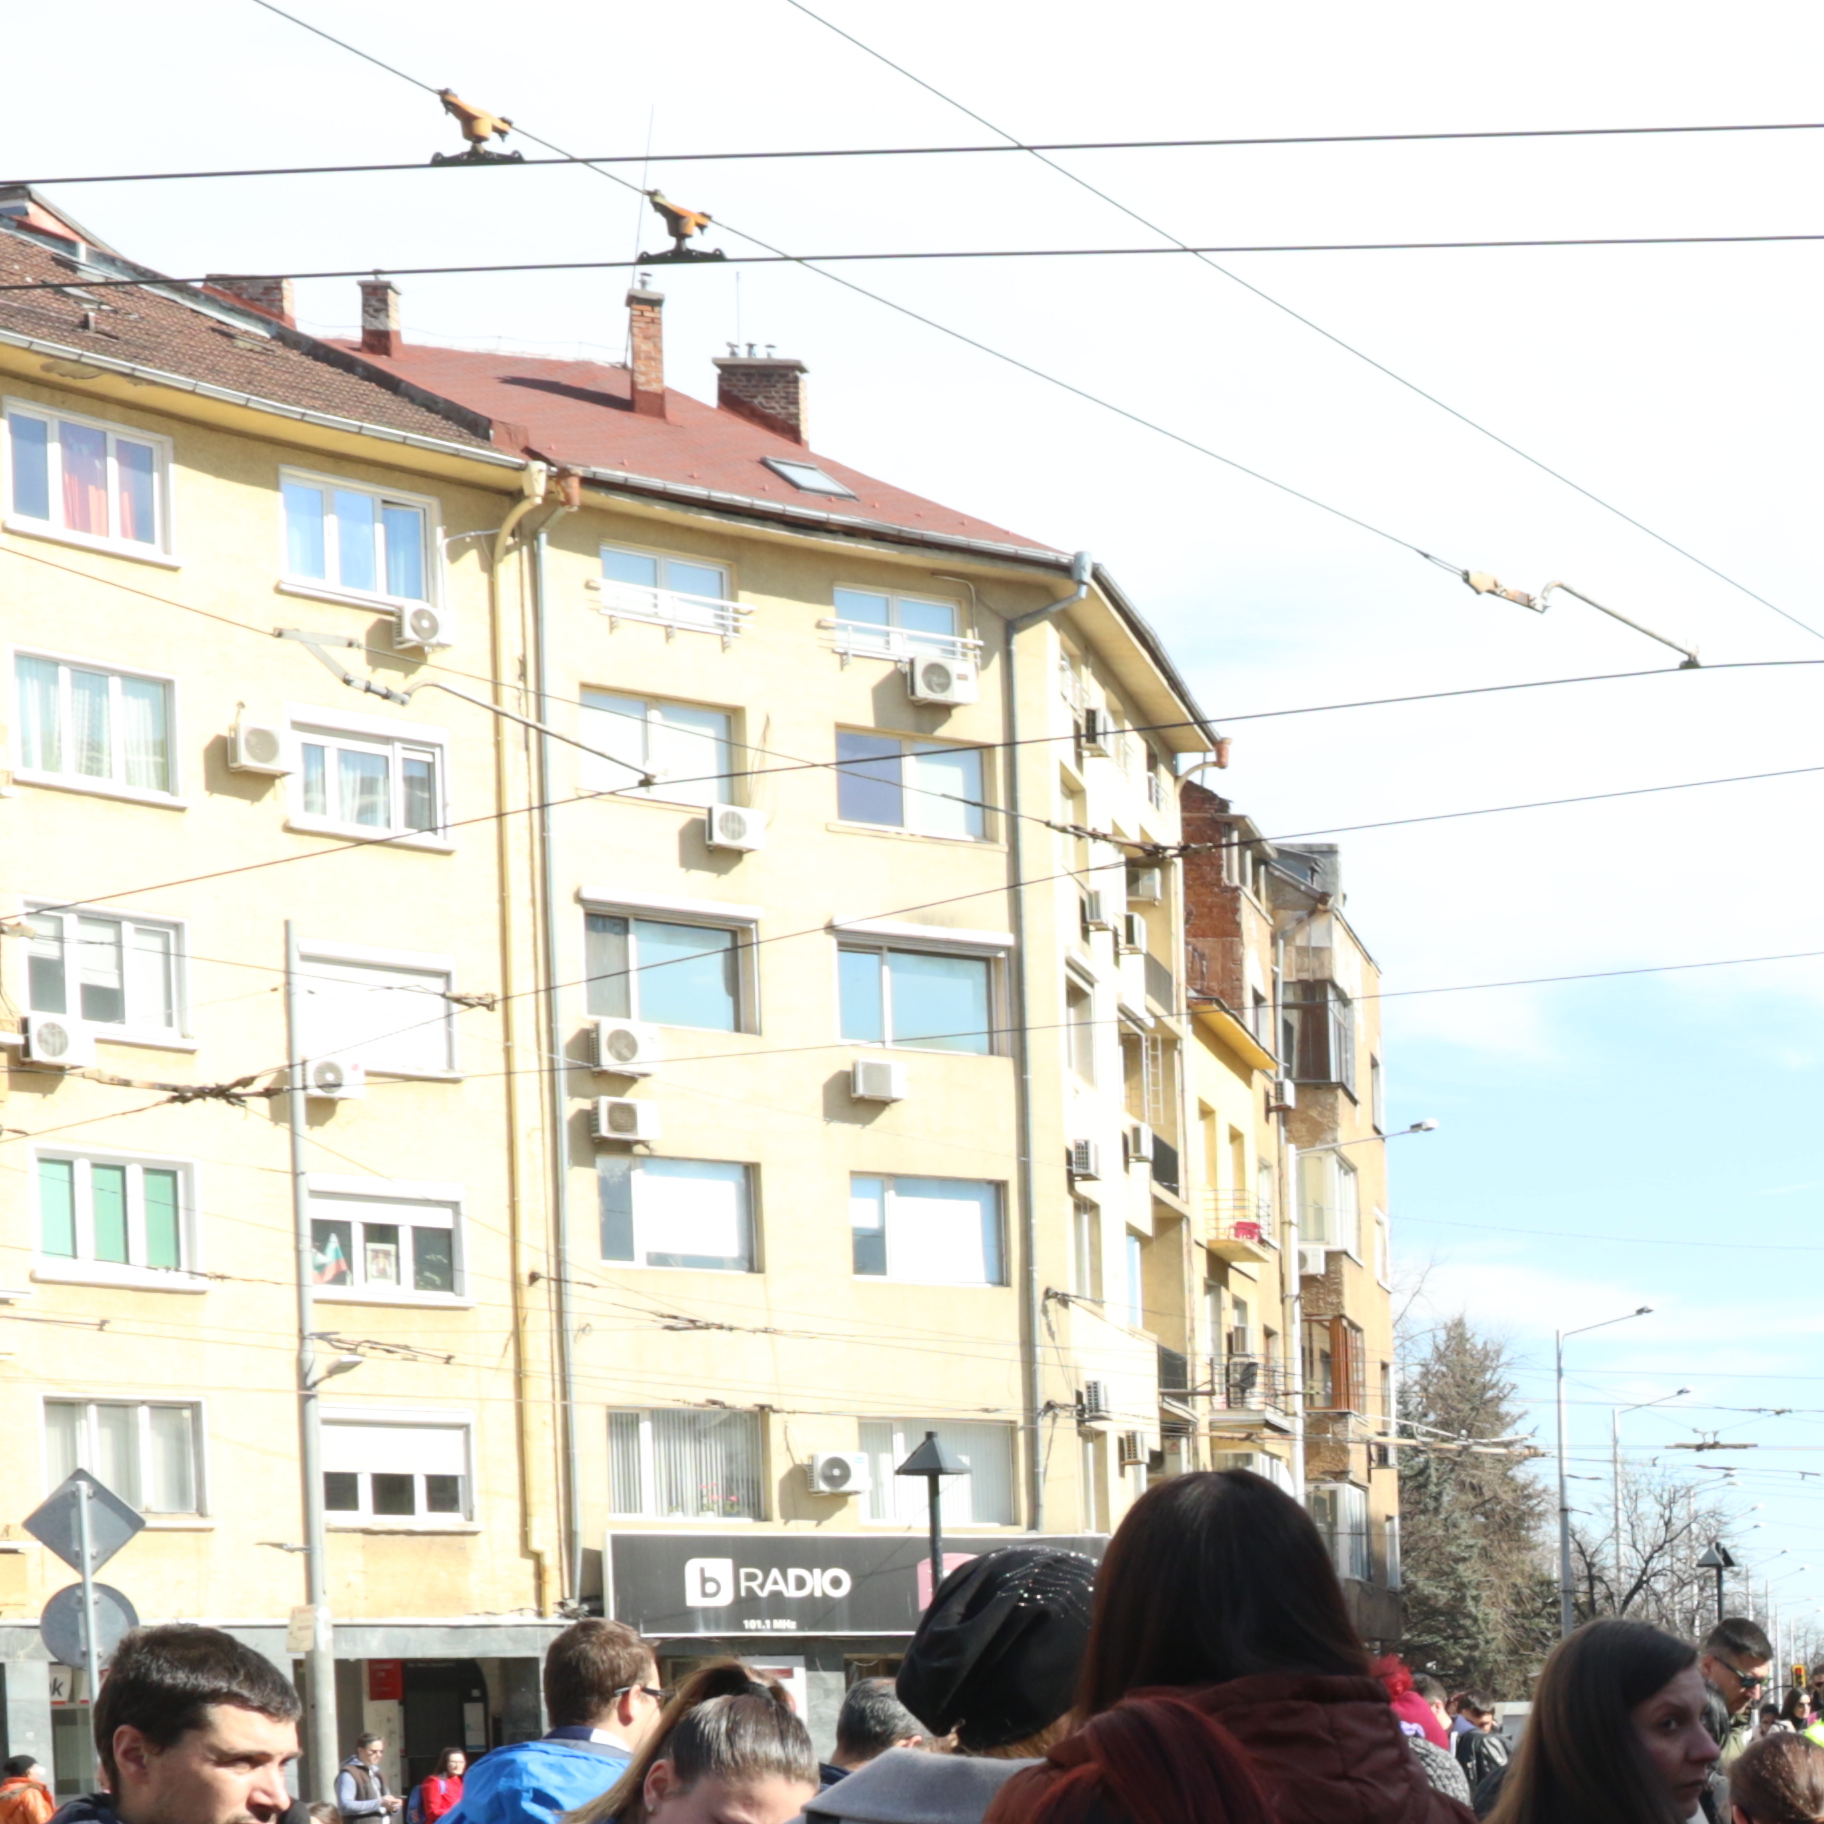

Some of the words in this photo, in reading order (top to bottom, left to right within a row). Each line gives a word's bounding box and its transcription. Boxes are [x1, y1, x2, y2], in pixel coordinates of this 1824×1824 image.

[739, 1568, 852, 1598] RADIO
[743, 1619, 771, 1630] 101.1
[773, 1619, 797, 1630] MHz
